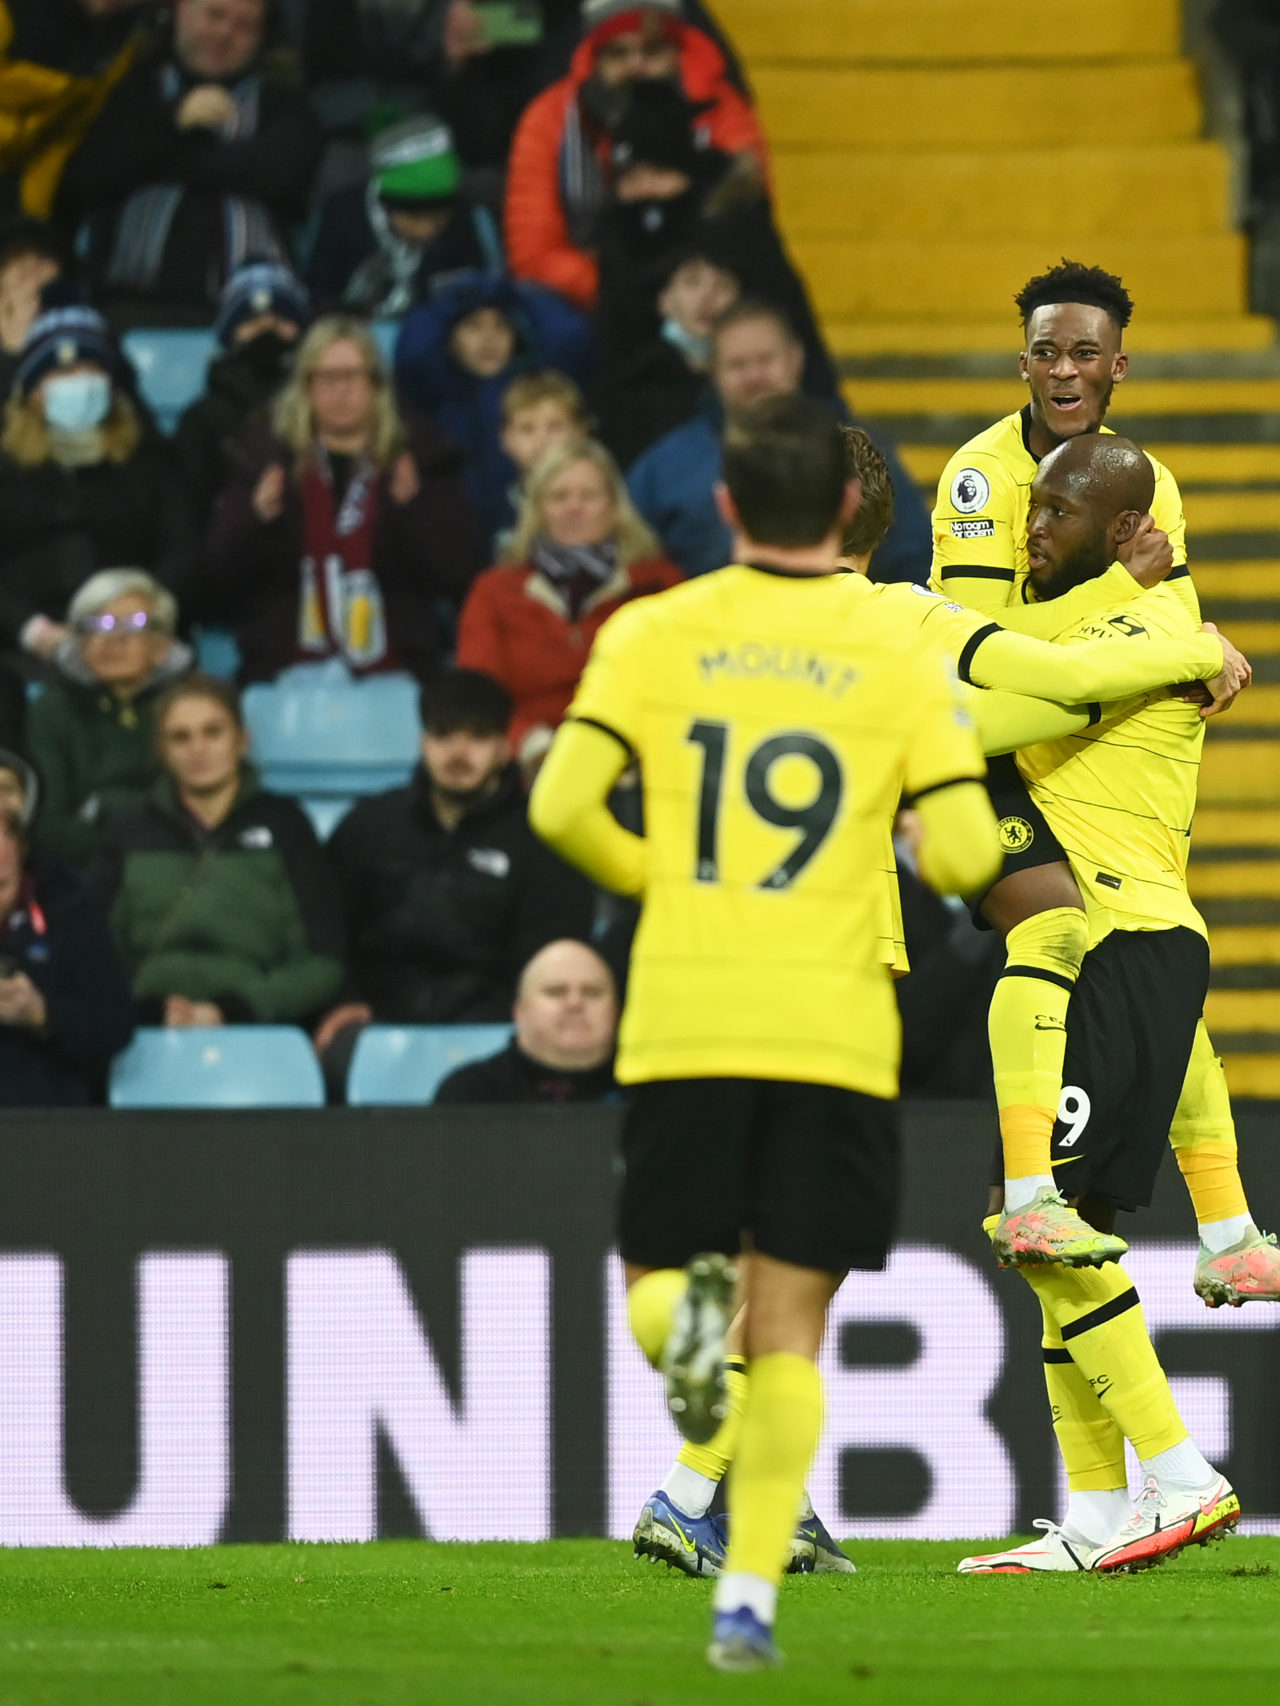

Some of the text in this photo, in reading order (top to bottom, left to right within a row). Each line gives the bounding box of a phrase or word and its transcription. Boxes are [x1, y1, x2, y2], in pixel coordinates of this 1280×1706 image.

[963, 520, 990, 530] room
[698, 642, 856, 698] MOUNT
[686, 720, 843, 889] 19
[1057, 1085, 1091, 1147] 9
